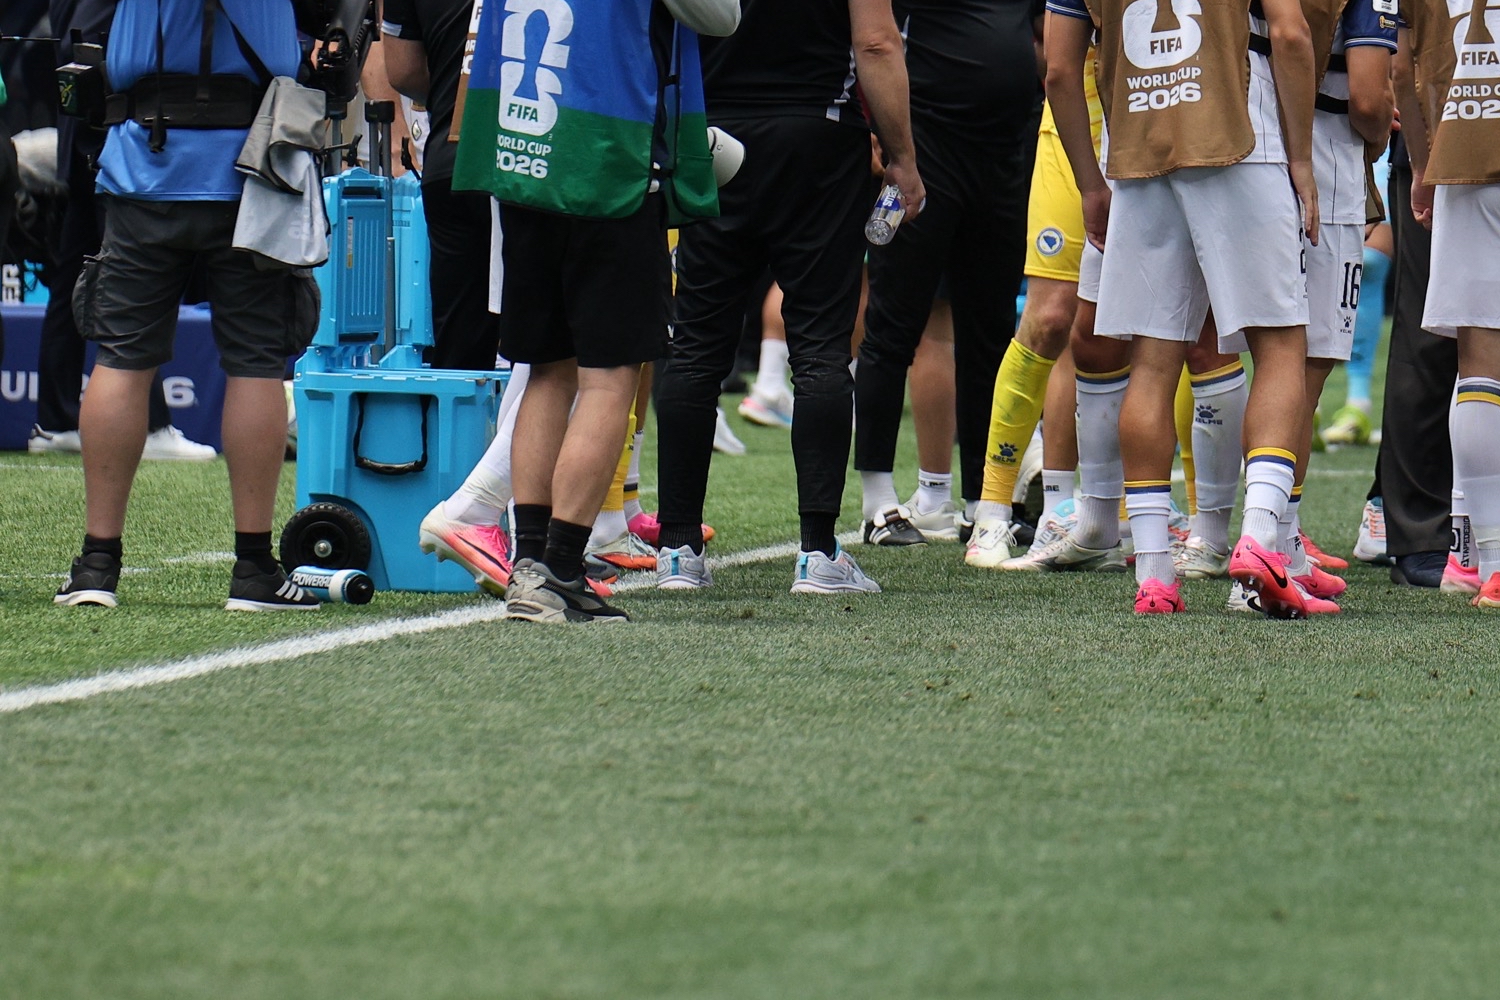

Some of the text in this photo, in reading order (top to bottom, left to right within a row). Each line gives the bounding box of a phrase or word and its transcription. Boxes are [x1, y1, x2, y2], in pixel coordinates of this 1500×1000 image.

[1150, 36, 1182, 55] FIFA
[1461, 51, 1500, 66] FIFA
[1127, 71, 1177, 90] WORLD
[1127, 81, 1202, 113] 2026
[1447, 84, 1492, 100] ORLD
[507, 103, 539, 123] FIFA
[497, 134, 552, 158] ORLD CUP
[1341, 262, 1363, 310] 16
[292, 573, 333, 587] POWERAD
